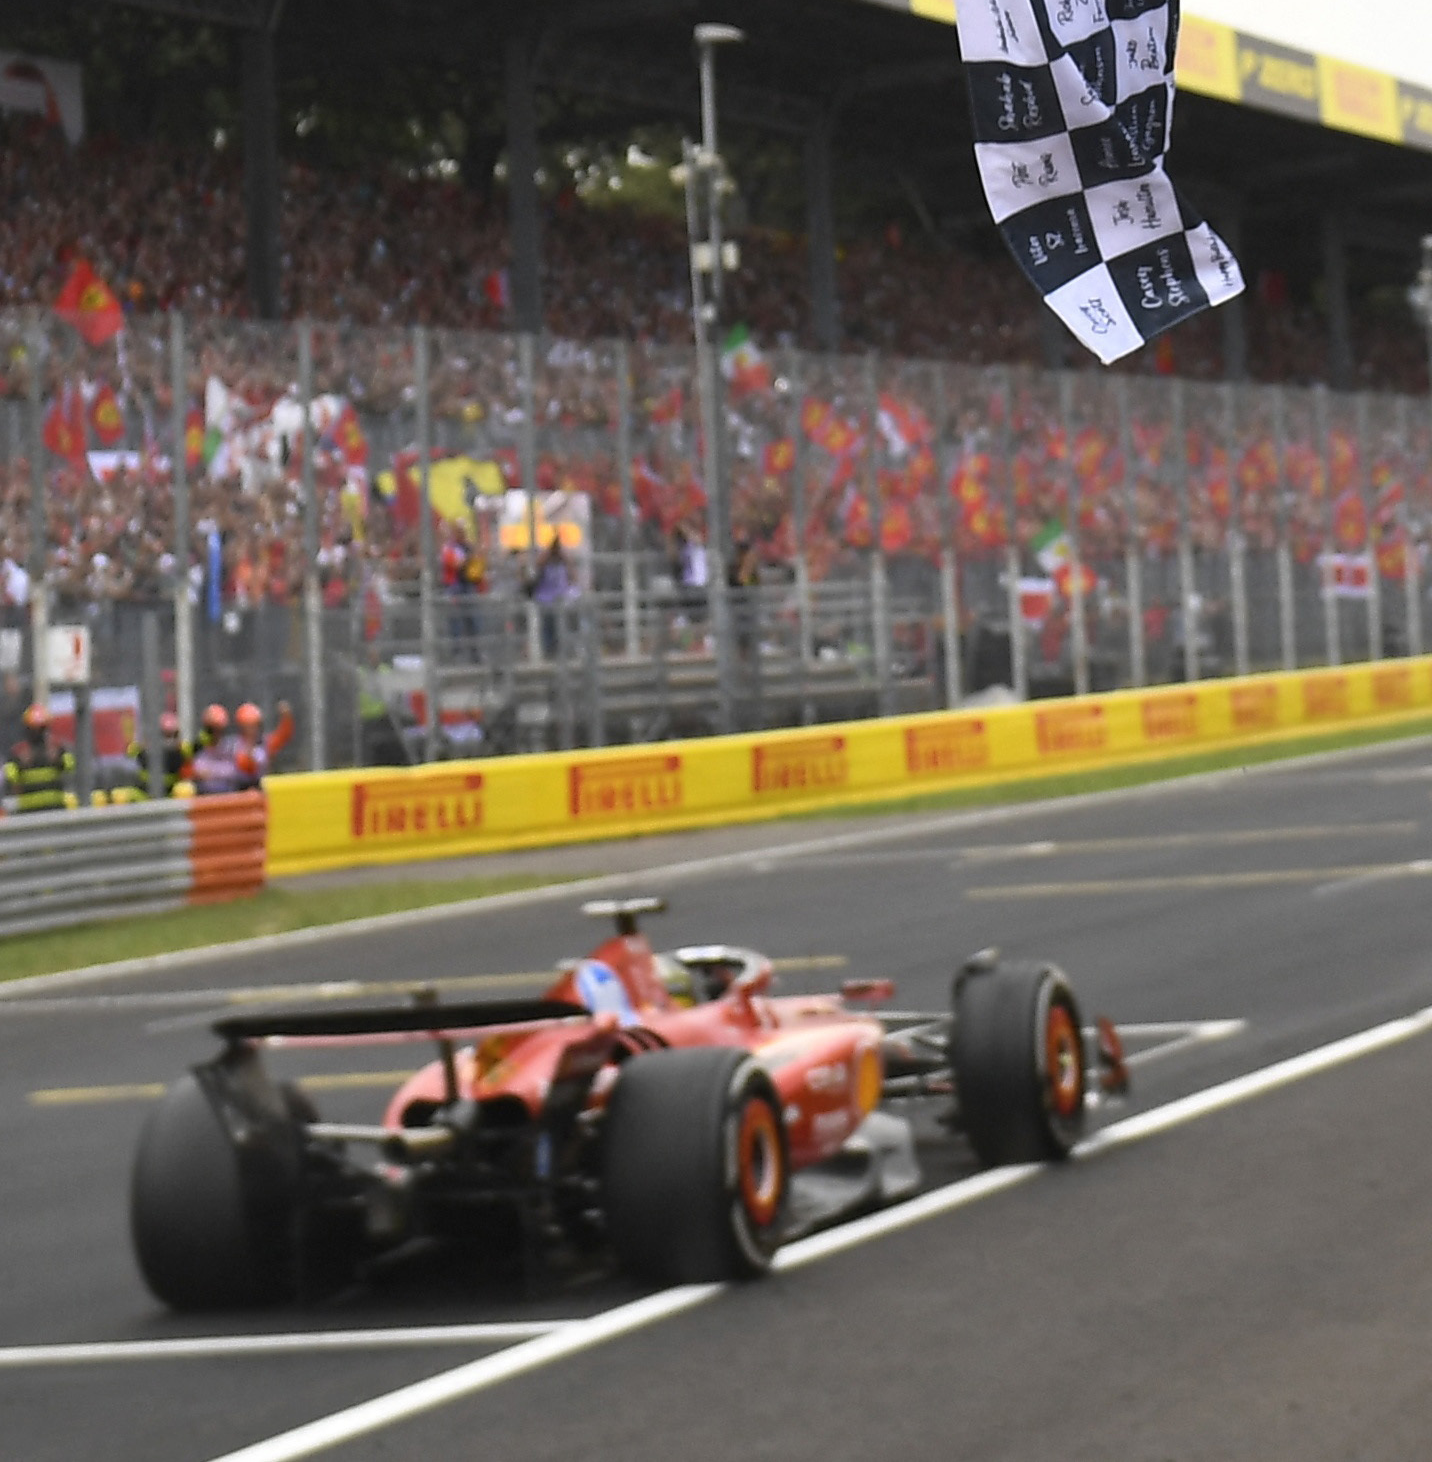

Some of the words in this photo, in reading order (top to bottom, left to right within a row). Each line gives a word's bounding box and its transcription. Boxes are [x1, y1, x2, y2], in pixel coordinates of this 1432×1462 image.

[1136, 266, 1164, 309] Casey
[1156, 248, 1191, 307] Stephens
[570, 755, 682, 818] PIRELLI
[751, 736, 847, 793] PIRELLI
[351, 774, 484, 838] PIRELLI
